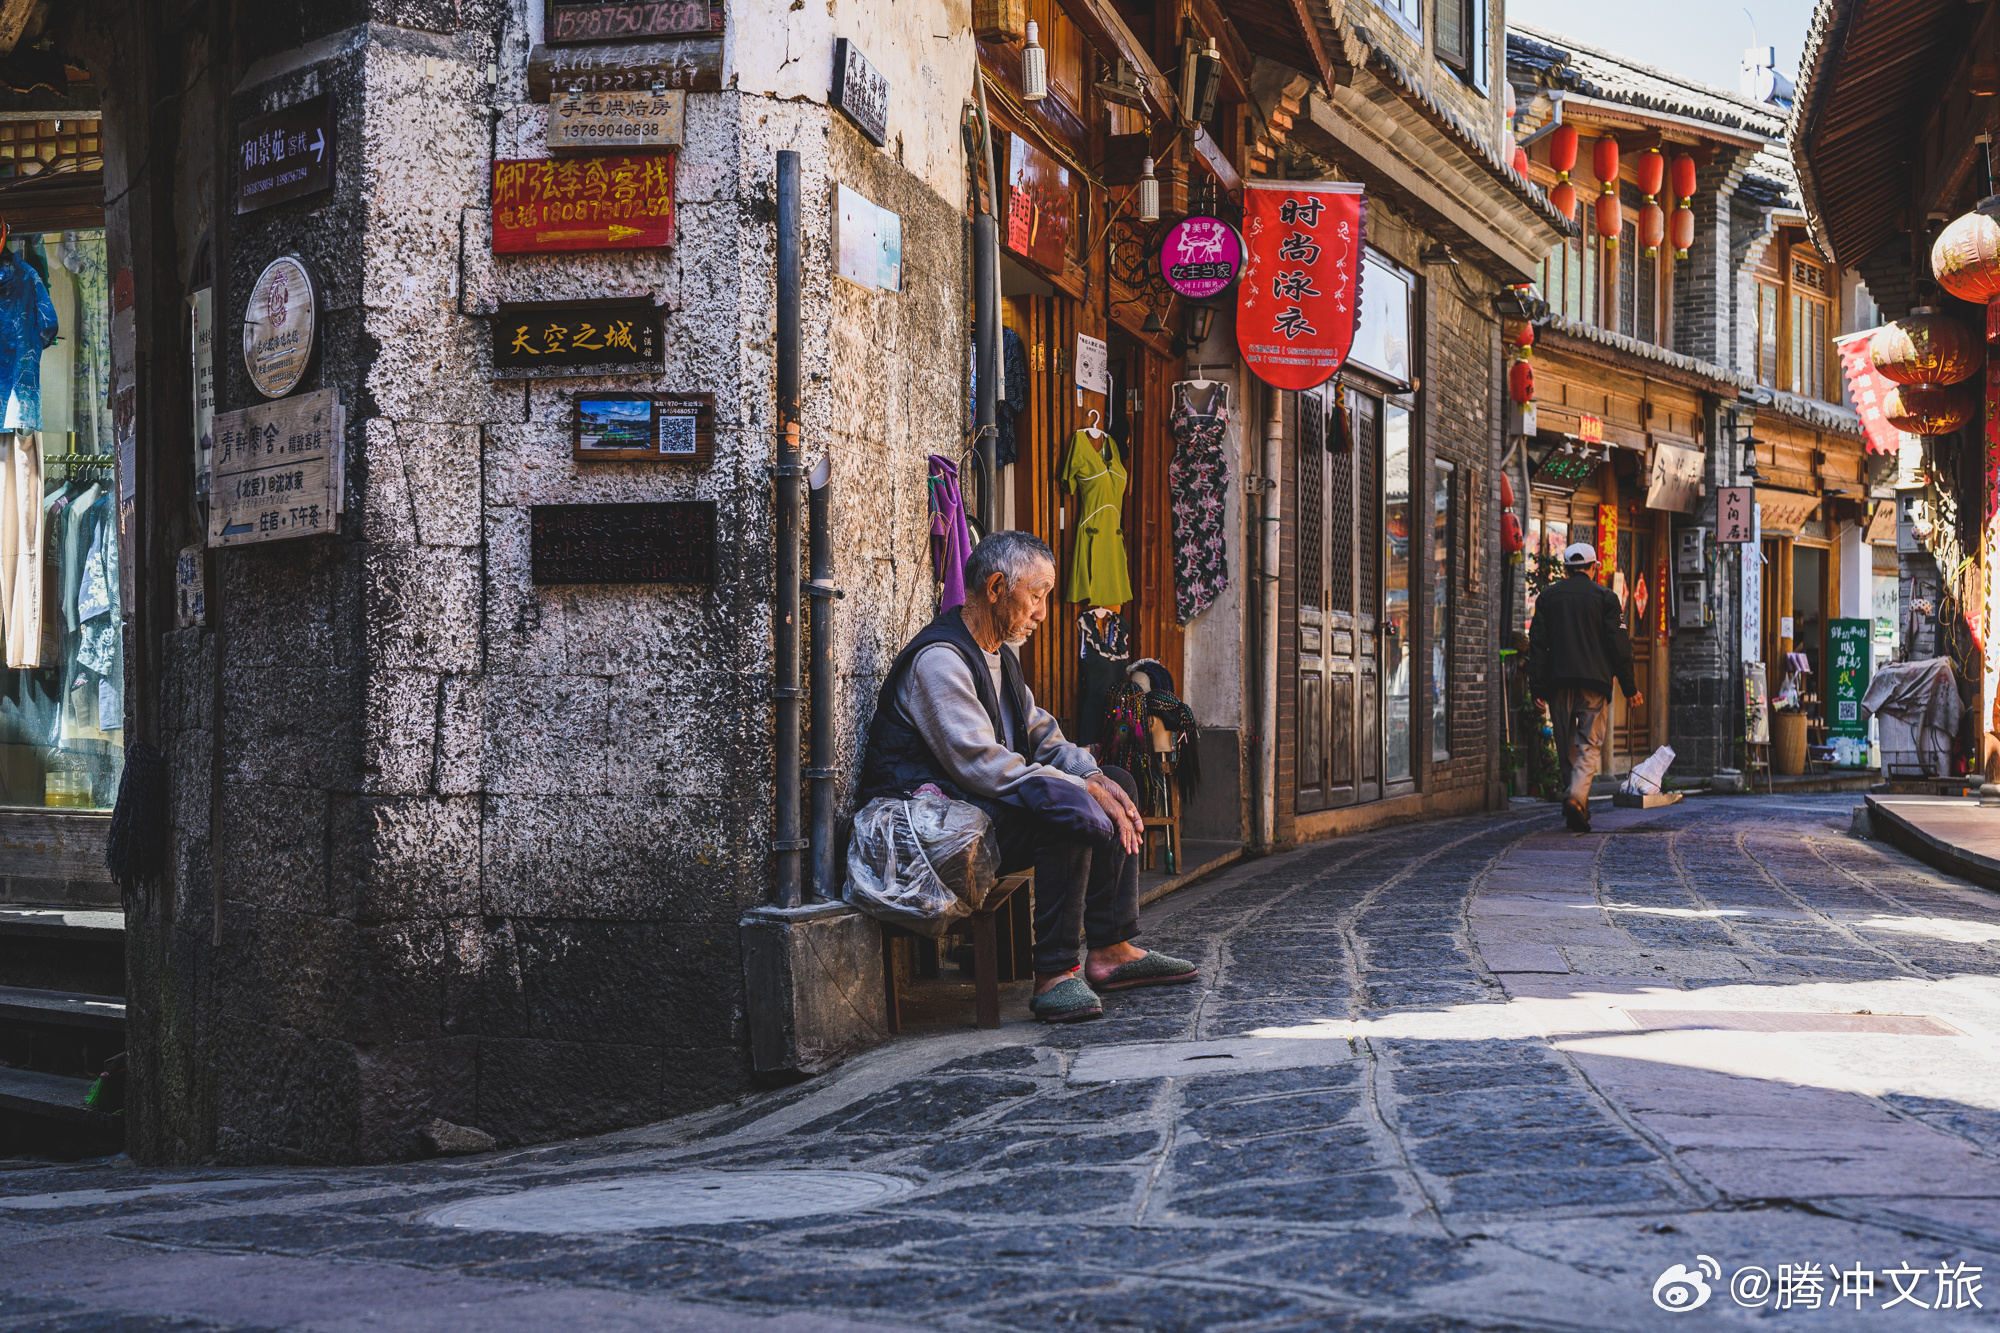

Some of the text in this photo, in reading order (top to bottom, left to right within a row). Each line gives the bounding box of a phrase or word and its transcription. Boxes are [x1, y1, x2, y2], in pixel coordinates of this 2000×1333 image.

[560, 99, 671, 118] 手工烘焙房
[563, 123, 659, 138] 13769046838
[1192, 223, 1211, 233] 美甲
[1171, 262, 1231, 279] 女主当家
[1273, 197, 1325, 339] 时尚泳衣
[510, 320, 637, 355] 天空之城
